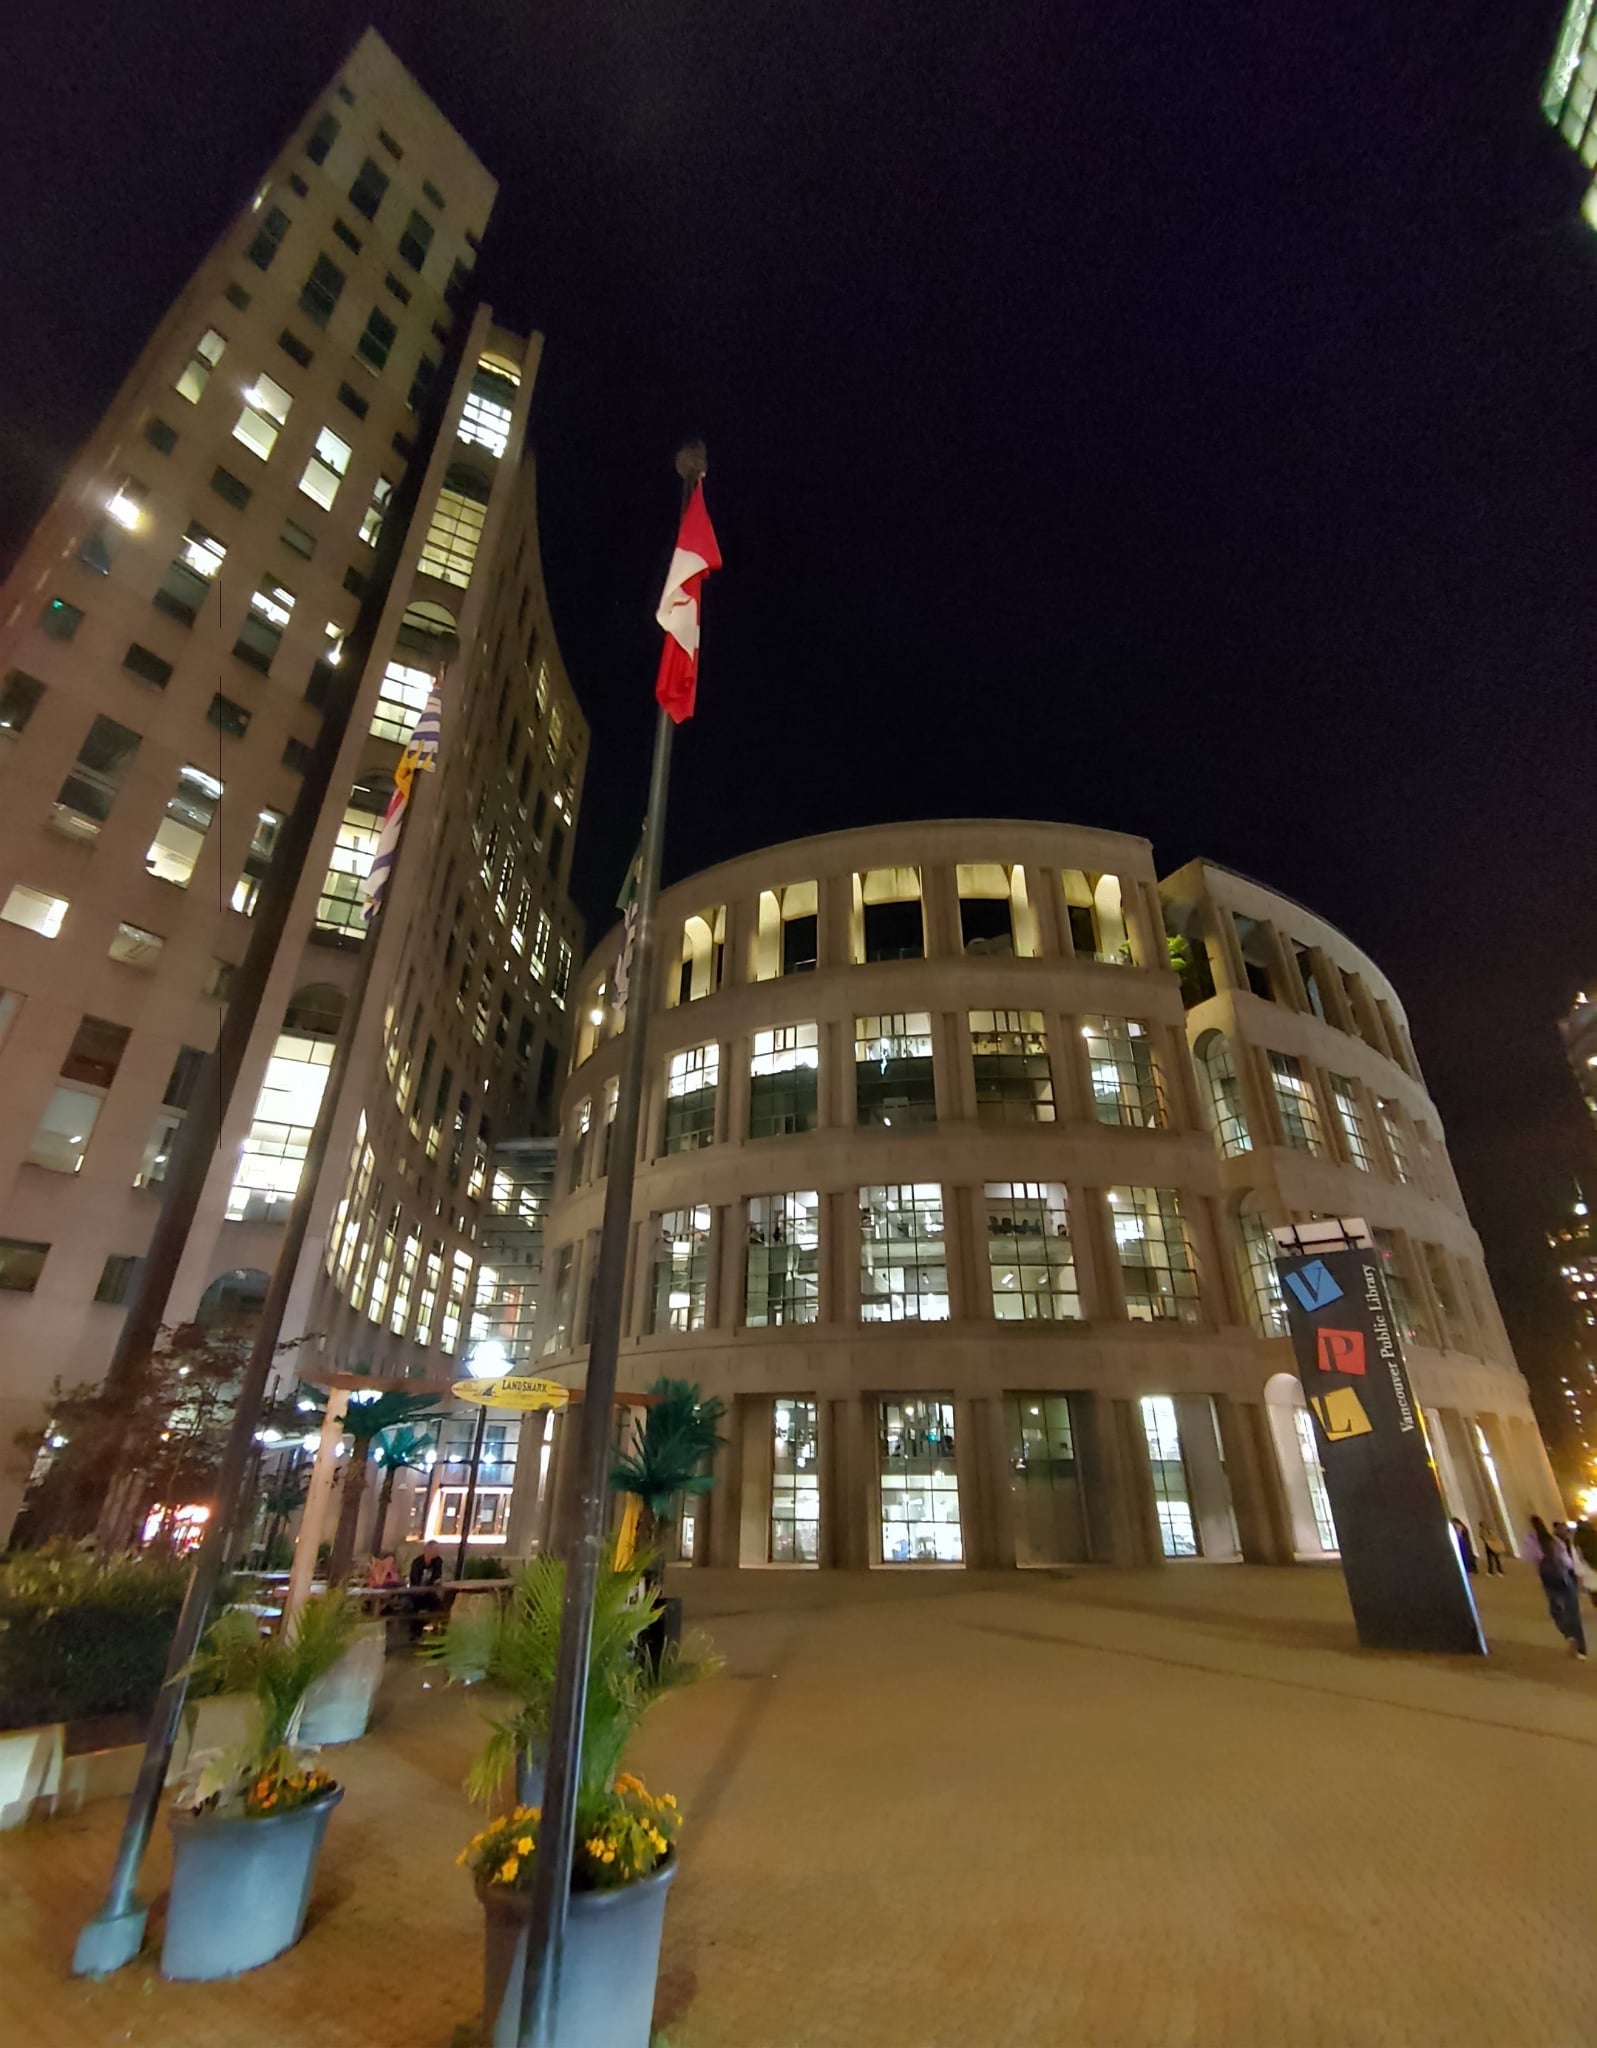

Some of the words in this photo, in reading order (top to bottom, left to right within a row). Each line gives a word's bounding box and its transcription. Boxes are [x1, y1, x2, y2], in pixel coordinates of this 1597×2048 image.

[1294, 1266, 1322, 1303] V
[1362, 1264, 1383, 1313] Library
[1319, 1335, 1353, 1372] P
[1374, 1315, 1395, 1359] Public
[1315, 1393, 1352, 1433] L
[1388, 1362, 1414, 1432] Vancouver
